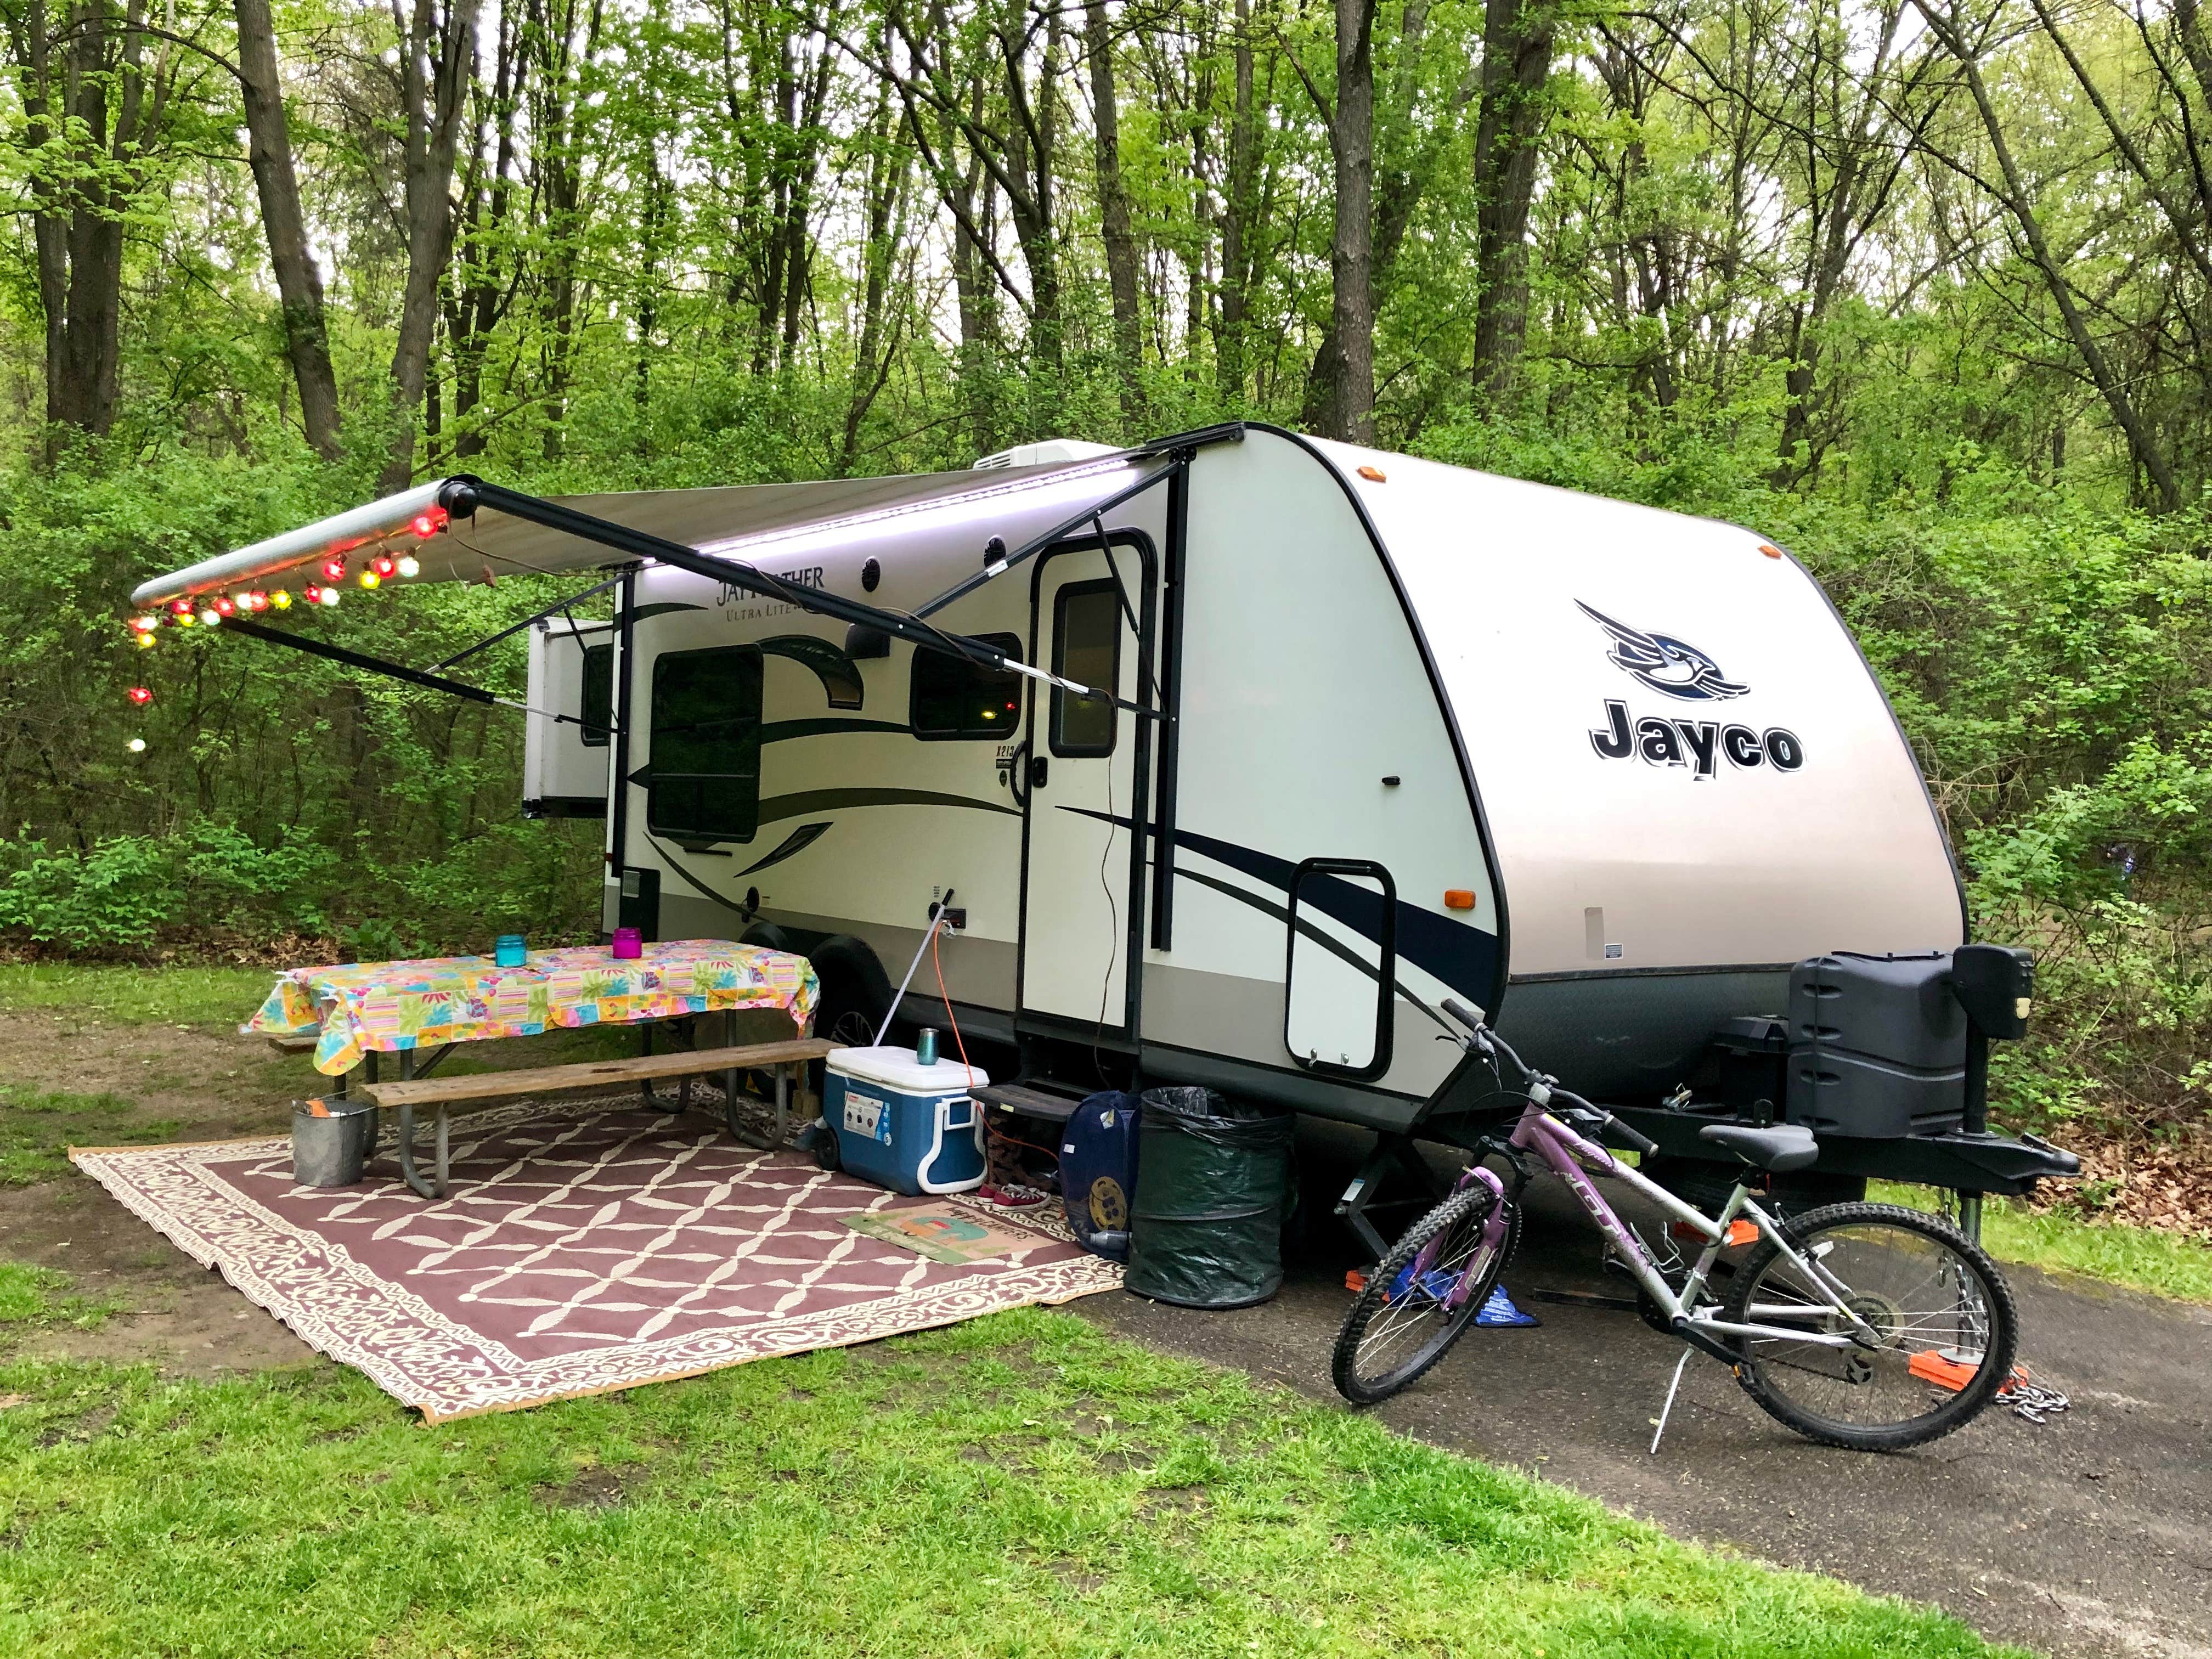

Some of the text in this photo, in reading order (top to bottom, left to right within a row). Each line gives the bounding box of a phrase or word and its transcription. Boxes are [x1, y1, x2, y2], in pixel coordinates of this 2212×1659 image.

[726, 608, 761, 622] ULTRA
[766, 604, 792, 617] LITE
[996, 746, 1014, 757] X213
[1588, 698, 1808, 781] Jayco
[1571, 1181, 1622, 1234] GT
